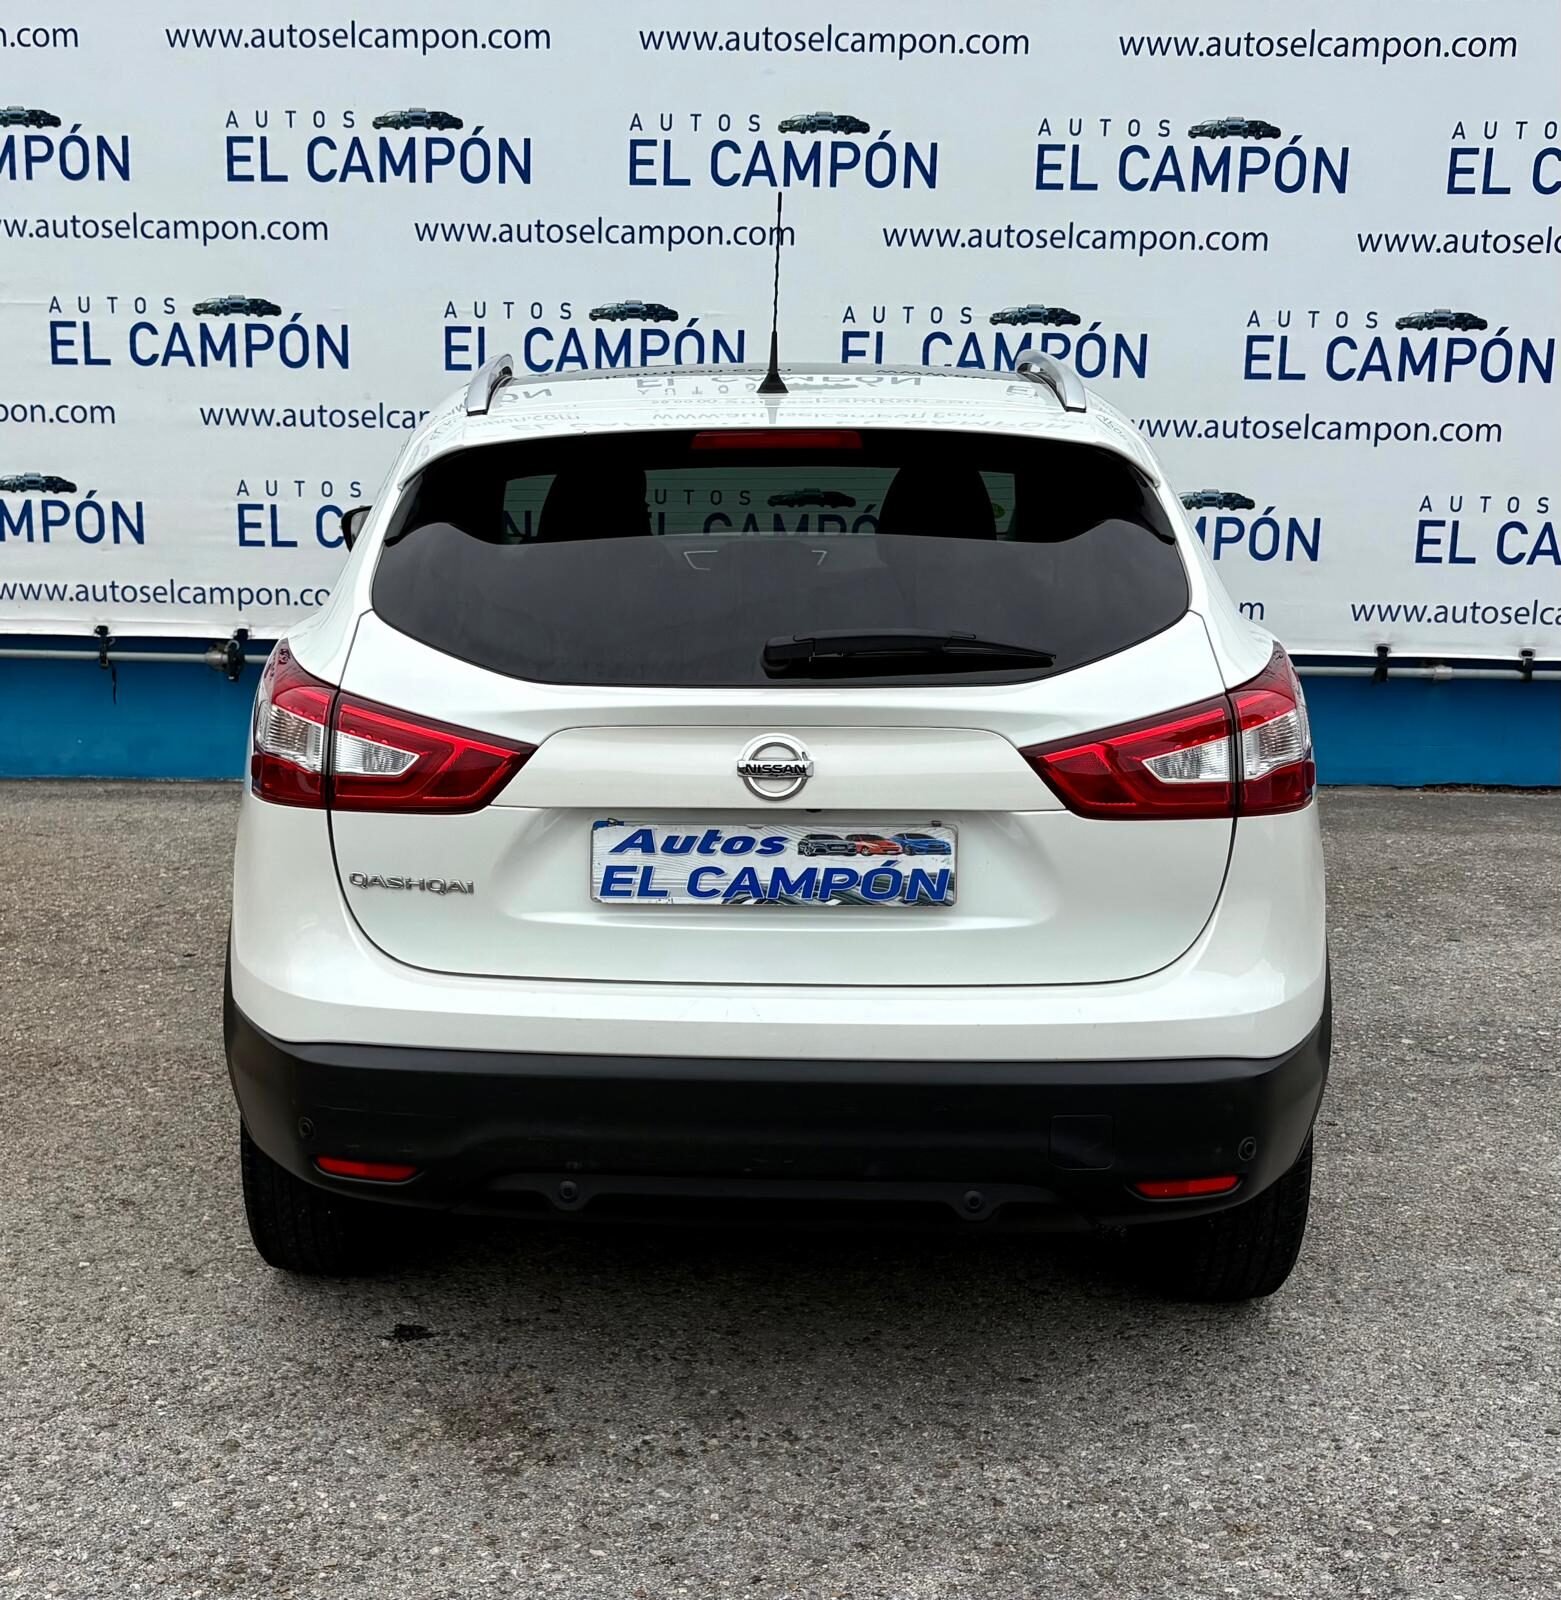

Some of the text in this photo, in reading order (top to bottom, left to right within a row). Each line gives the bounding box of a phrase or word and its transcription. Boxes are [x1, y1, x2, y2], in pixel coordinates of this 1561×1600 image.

[165, 20, 551, 56] www.autoselcampon.com
[639, 23, 1029, 61] www.autoselcampon.com
[1119, 28, 1517, 65] www.autoselcampon.com
[225, 110, 355, 129] AUTOS
[629, 112, 761, 133] AUTOS
[1037, 117, 1170, 138] AUTOS
[1451, 120, 1558, 140] AUTO
[226, 126, 531, 185] EL CAMPÓN
[629, 130, 938, 189] EL CAMPÓN
[1035, 135, 1350, 194] EL CAMPÓN
[1446, 147, 1511, 195] EL
[0, 211, 328, 247] w.autoselcampon.com
[414, 216, 795, 251] www.autoselcampon.com
[882, 221, 1269, 257] www.autoselcampon.com
[48, 295, 176, 315] AUTOS
[443, 300, 572, 320] AUTOS
[842, 305, 972, 325] AUTOS
[1246, 309, 1378, 329] AUTOS
[49, 312, 349, 370] EL CAMPÓN
[524, 318, 745, 373] CAMPÓN
[1243, 327, 1556, 384] EL CAMPÓN
[236, 479, 362, 498] AUTOS
[1418, 495, 1549, 514] AUTOS
[237, 503, 298, 548] EL
[1414, 519, 1477, 565] EL
[745, 763, 806, 774] NISSAN
[608, 828, 788, 856] Autos
[349, 871, 475, 896] QASHQAI
[599, 860, 953, 902] EL CAMPÓN
